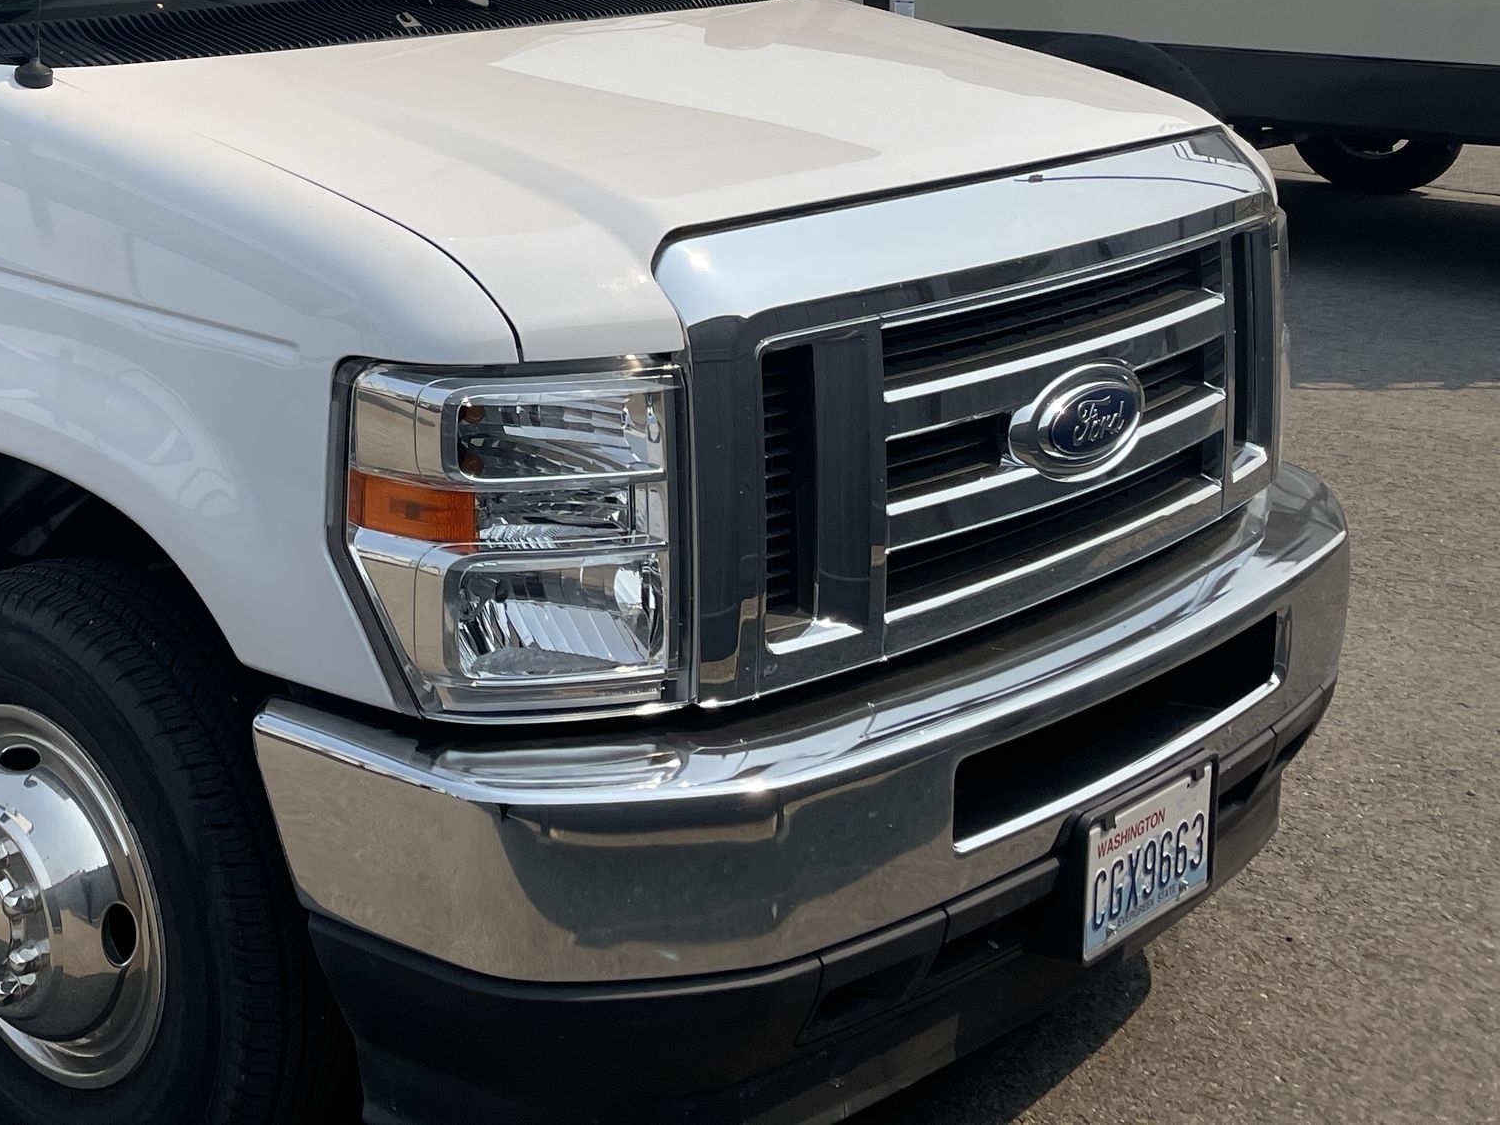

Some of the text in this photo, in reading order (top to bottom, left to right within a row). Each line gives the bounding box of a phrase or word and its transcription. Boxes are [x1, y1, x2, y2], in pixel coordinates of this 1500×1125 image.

[1072, 395, 1125, 446] Ford
[1097, 808, 1166, 859] WASHINGTON
[1093, 813, 1205, 931] CGX9663
